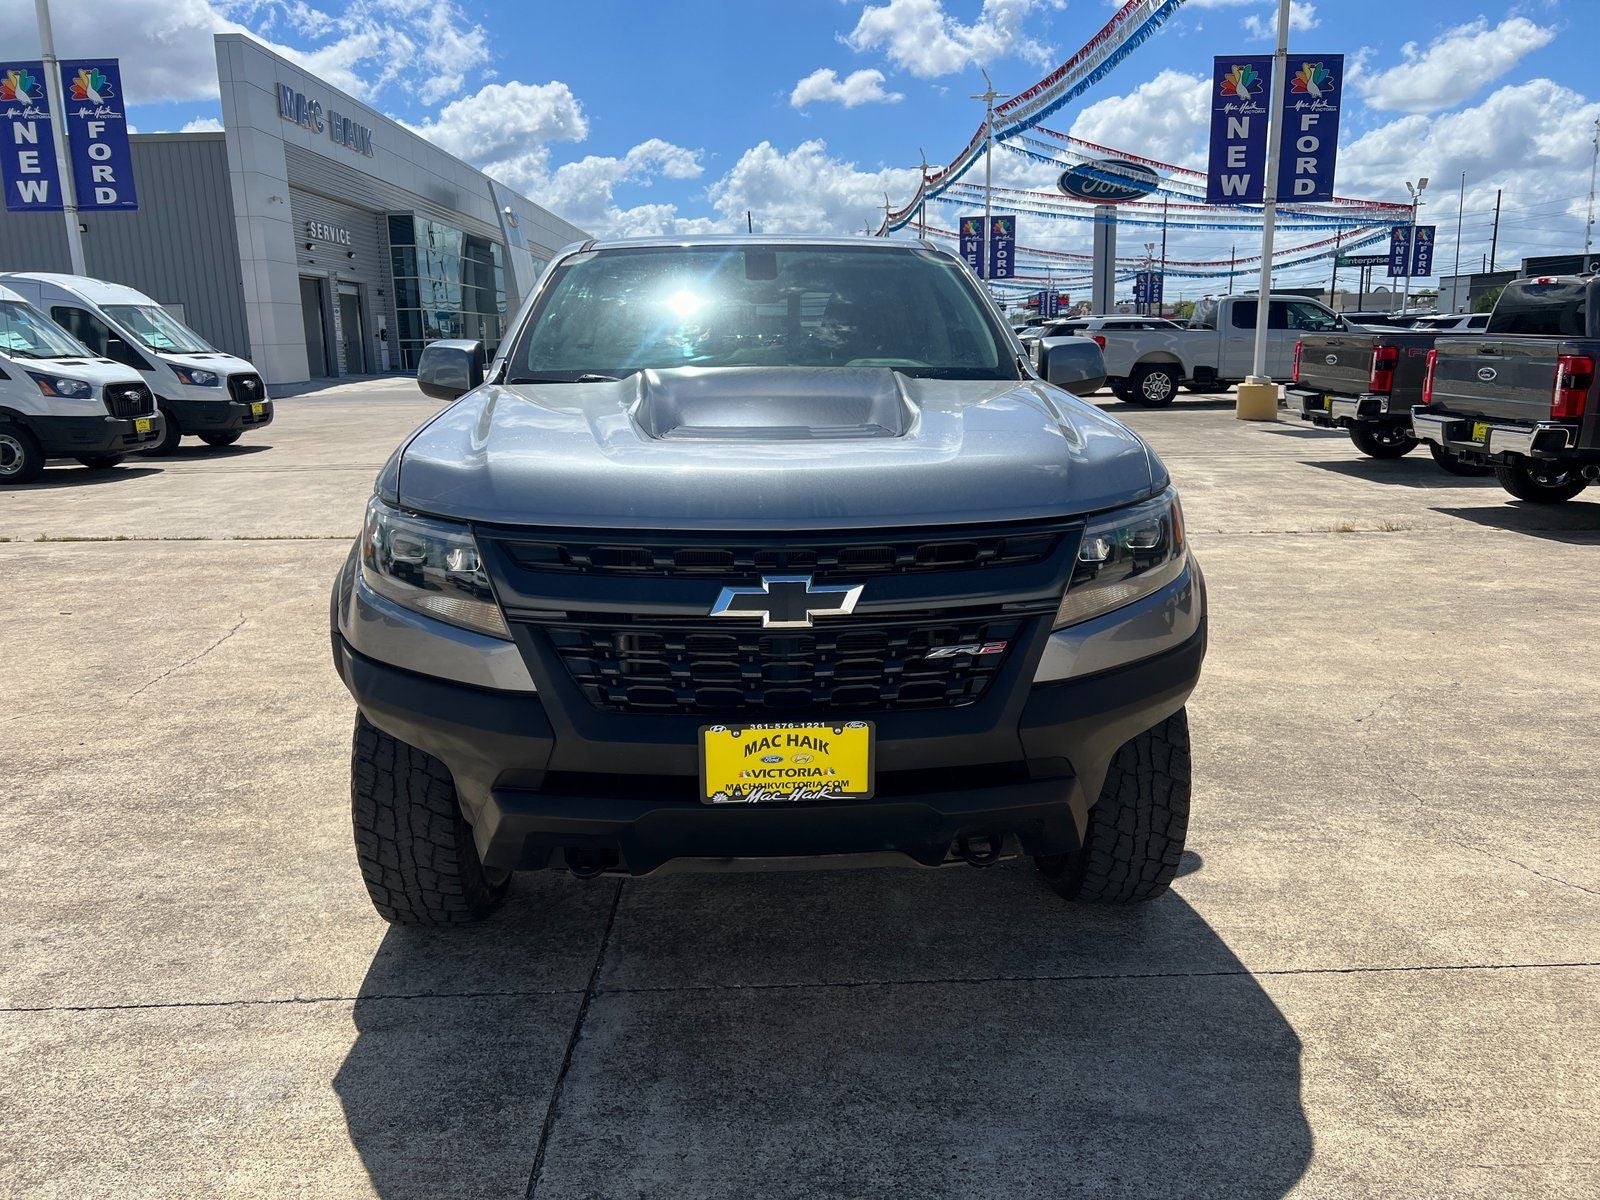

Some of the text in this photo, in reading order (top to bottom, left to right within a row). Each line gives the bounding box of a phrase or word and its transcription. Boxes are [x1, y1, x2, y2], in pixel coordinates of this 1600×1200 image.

[1223, 102, 1239, 114] Mac
[1294, 100, 1310, 112] Mac
[276, 82, 374, 158] MAC HAIK
[13, 121, 48, 203] NEW
[87, 121, 117, 204] FORD
[1220, 116, 1251, 196] NEW
[1293, 113, 1320, 196] FORD
[310, 221, 351, 245] SERVICE
[996, 241, 1008, 277] FORD
[1341, 256, 1390, 265] enterprise
[1392, 246, 1404, 275] NEW
[1417, 245, 1428, 275] FORD
[924, 641, 1008, 659] ZR2
[750, 722, 825, 730] 361-576-1221
[744, 733, 830, 758] MAC HAIK
[751, 767, 823, 778] VICTORIA
[725, 780, 849, 791] MACHAIKVICTORIACOM
[744, 785, 831, 803] Mac Haik
